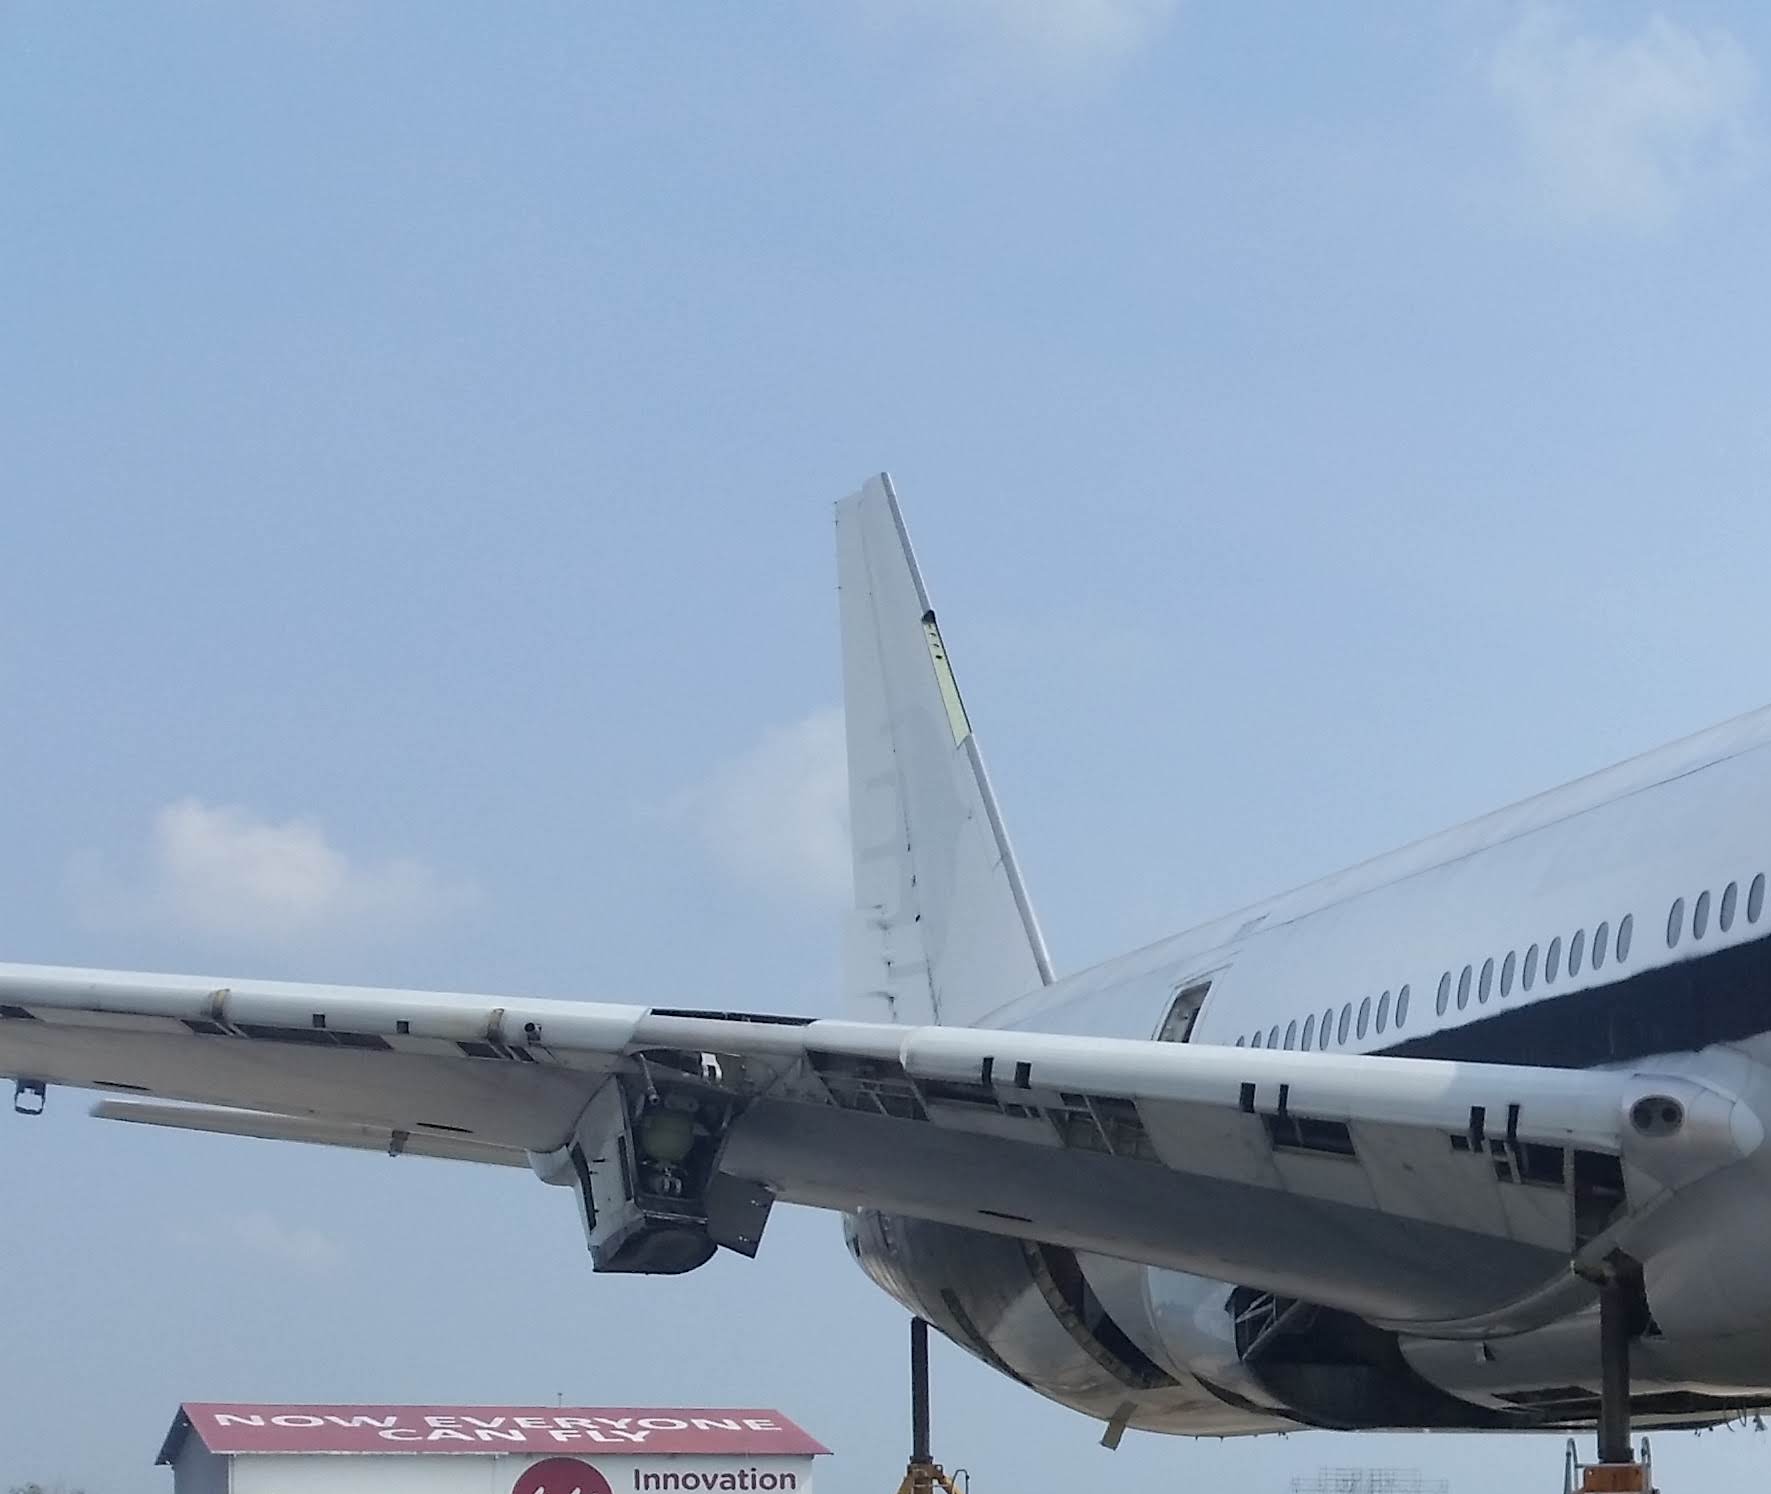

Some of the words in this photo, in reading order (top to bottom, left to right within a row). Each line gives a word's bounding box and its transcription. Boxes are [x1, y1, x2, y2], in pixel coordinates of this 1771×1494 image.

[214, 1414, 398, 1427] NOW
[424, 1416, 783, 1431] EVERYONE
[378, 1429, 527, 1441] CAN
[548, 1430, 651, 1442] FLY
[633, 1468, 797, 1491] Innovation
